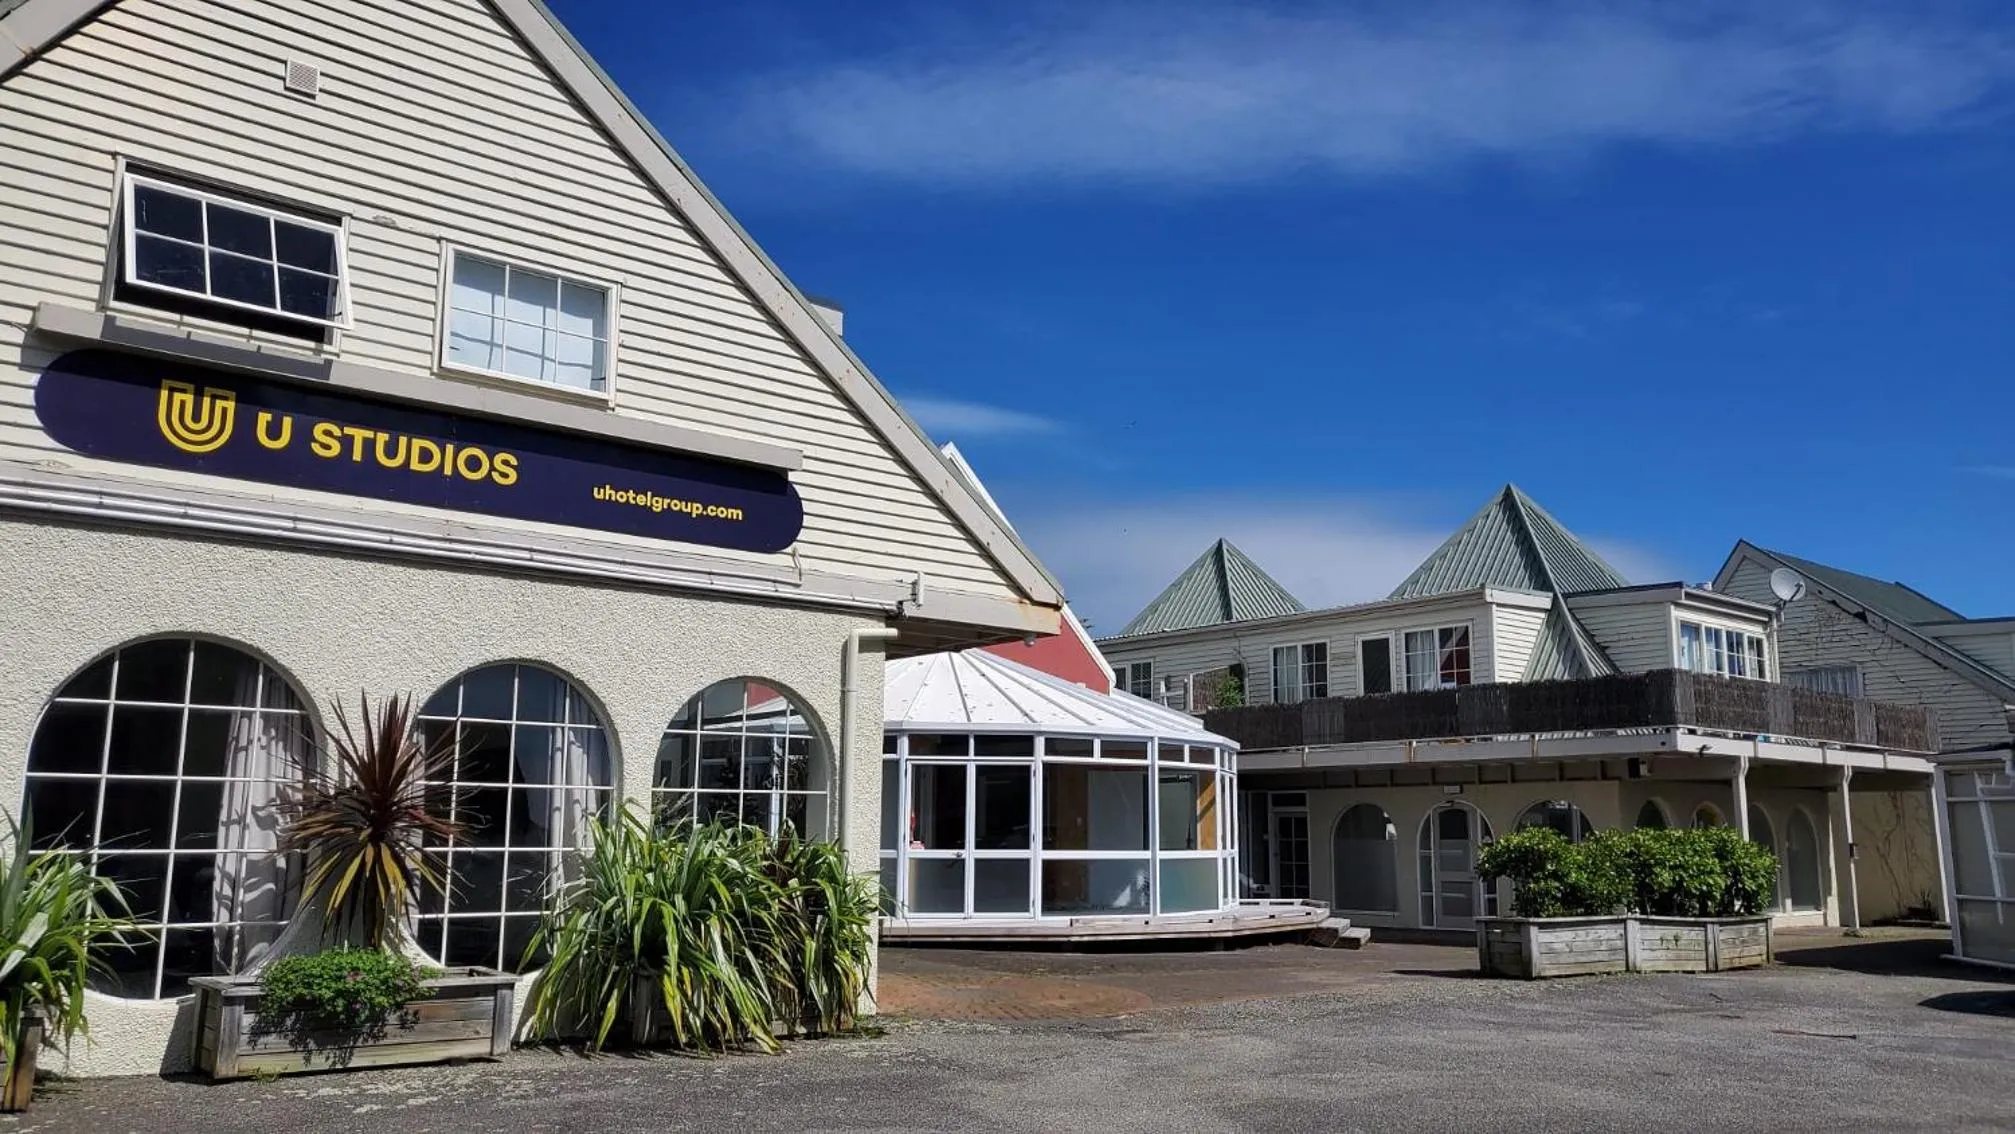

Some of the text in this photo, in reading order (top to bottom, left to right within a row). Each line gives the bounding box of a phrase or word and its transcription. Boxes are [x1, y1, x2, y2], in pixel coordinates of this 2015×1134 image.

[256, 411, 518, 485] U STUDIOS
[593, 485, 743, 520] uhotelgroup.com
